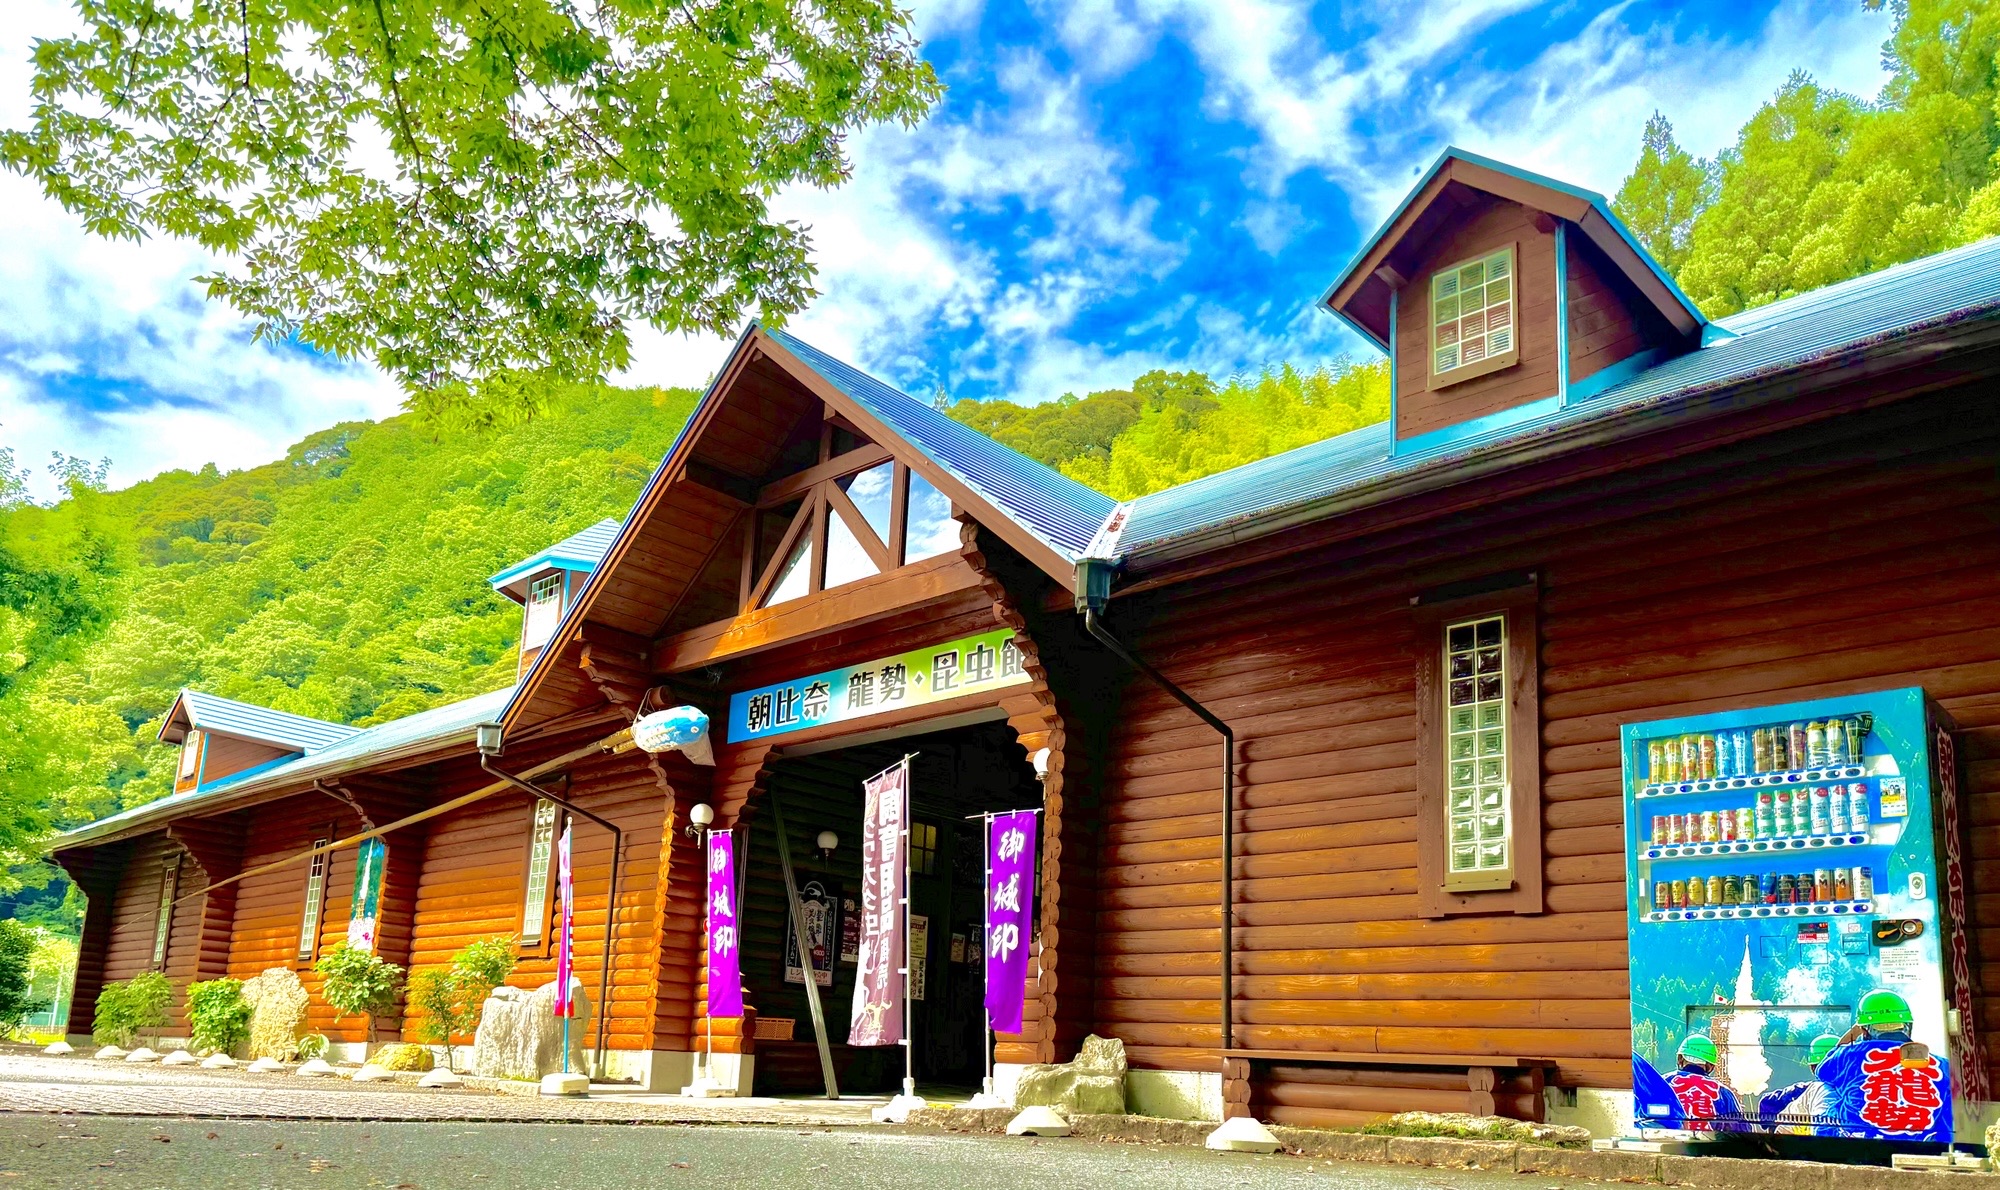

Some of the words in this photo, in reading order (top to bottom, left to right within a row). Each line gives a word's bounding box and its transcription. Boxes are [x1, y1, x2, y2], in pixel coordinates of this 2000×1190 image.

[747, 681, 830, 731] 朝比奈
[991, 826, 1025, 964] 御城印
